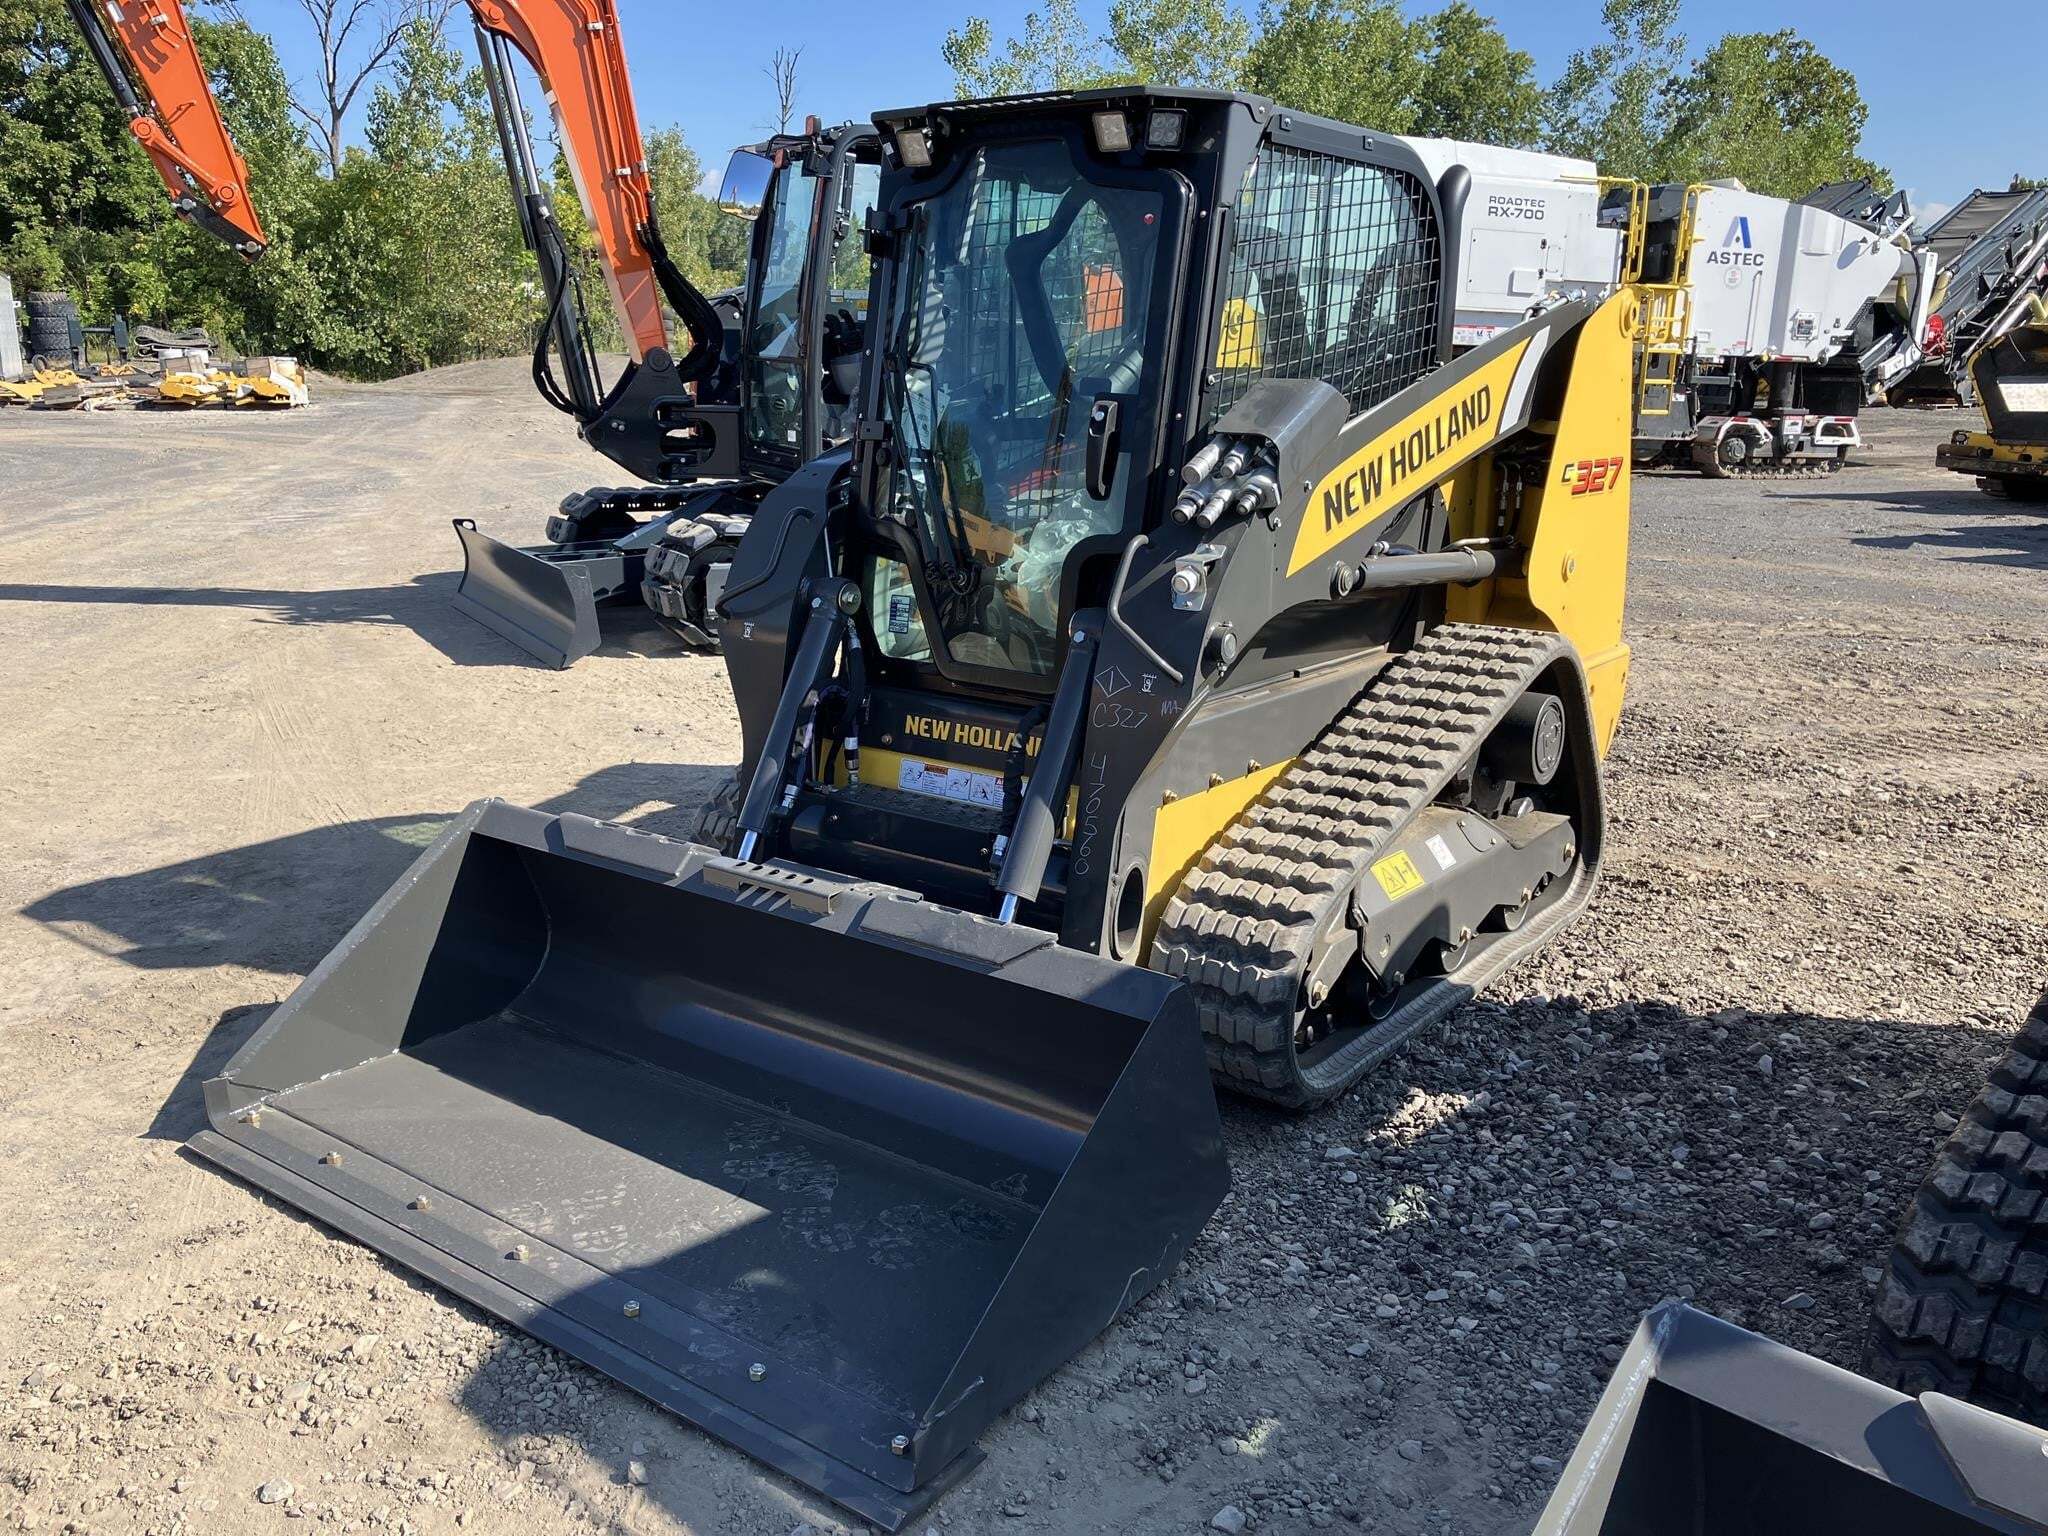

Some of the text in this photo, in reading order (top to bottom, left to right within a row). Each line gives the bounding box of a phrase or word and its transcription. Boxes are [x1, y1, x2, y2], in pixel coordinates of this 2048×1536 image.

[1489, 195, 1546, 208] ROADTEC
[1488, 206, 1545, 220] RX-700
[1707, 251, 1765, 266] ASTEC
[1323, 384, 1492, 533] NEW HOLLAND
[1093, 702, 1149, 729] C327
[904, 714, 951, 742] NEW
